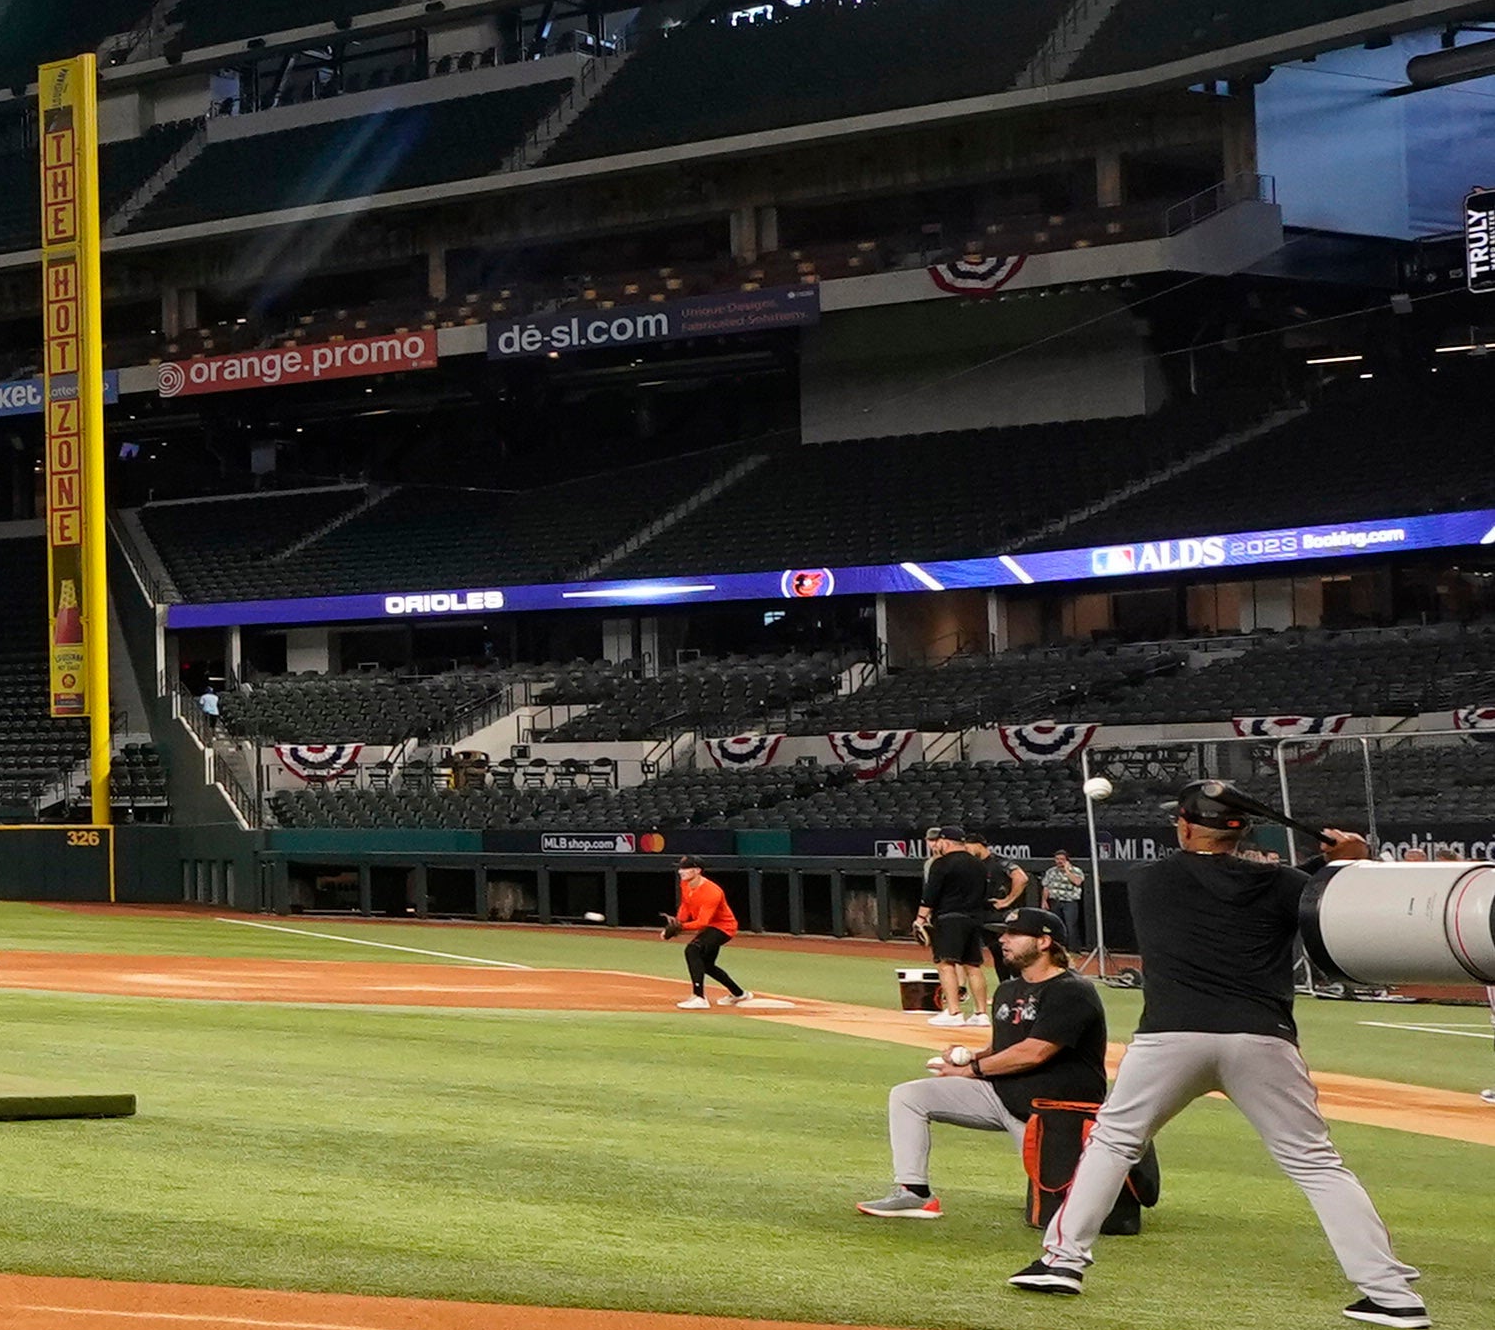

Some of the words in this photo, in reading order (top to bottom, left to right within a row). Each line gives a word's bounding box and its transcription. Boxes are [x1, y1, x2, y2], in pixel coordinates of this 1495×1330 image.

[52, 134, 68, 236] THE
[1467, 209, 1491, 279] TRULY
[53, 268, 70, 370] HOT
[190, 336, 425, 382] orange.promo
[57, 404, 74, 543] ZONE
[1139, 538, 1226, 571] ALDS
[1230, 535, 1298, 556] 2023
[1303, 528, 1405, 549] Booking.com
[385, 589, 504, 614] ORIOLES
[67, 830, 101, 846] 326
[1115, 838, 1155, 860] MLB
